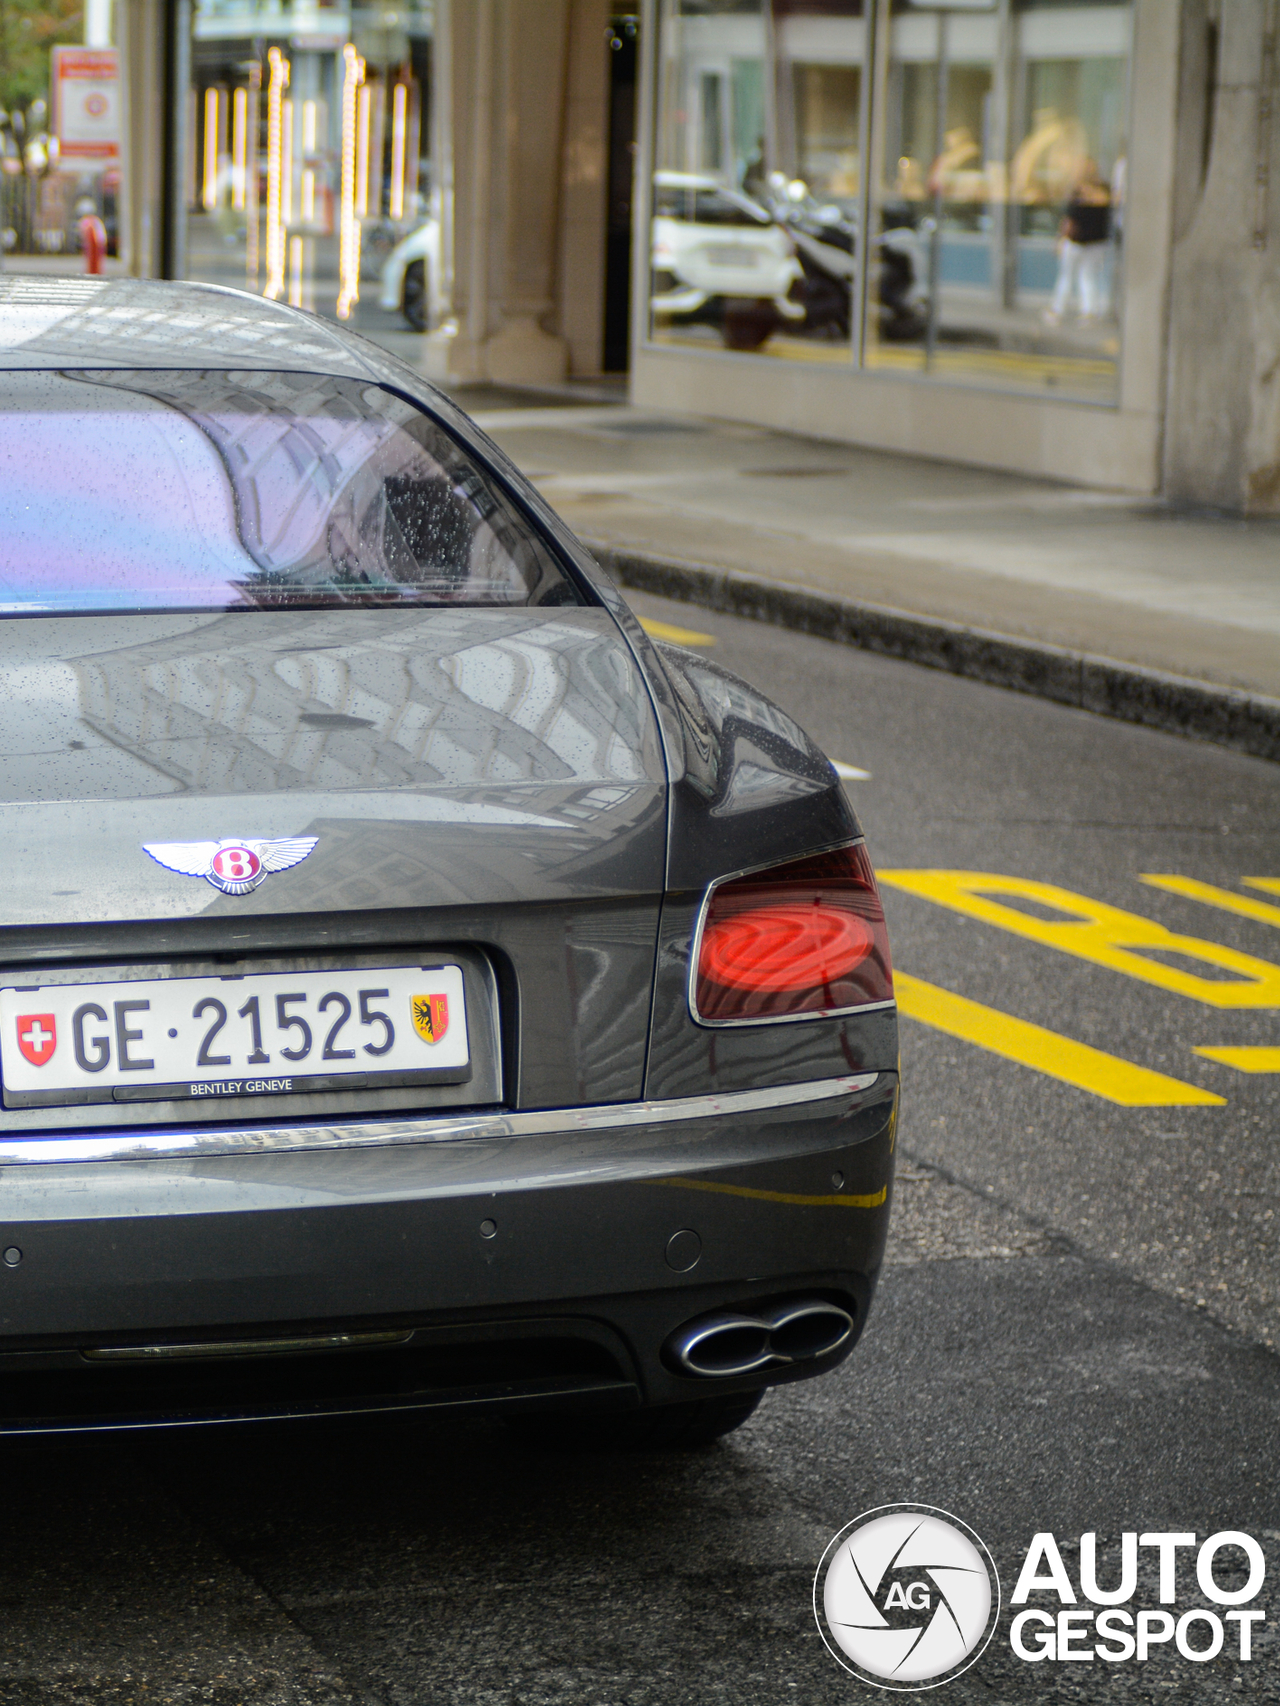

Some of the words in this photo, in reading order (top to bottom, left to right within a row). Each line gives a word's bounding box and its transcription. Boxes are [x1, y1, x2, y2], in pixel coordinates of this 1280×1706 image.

[220, 849, 253, 879] B
[190, 1082, 242, 1096] BENTLEY
[245, 1079, 293, 1093] GENEVE
